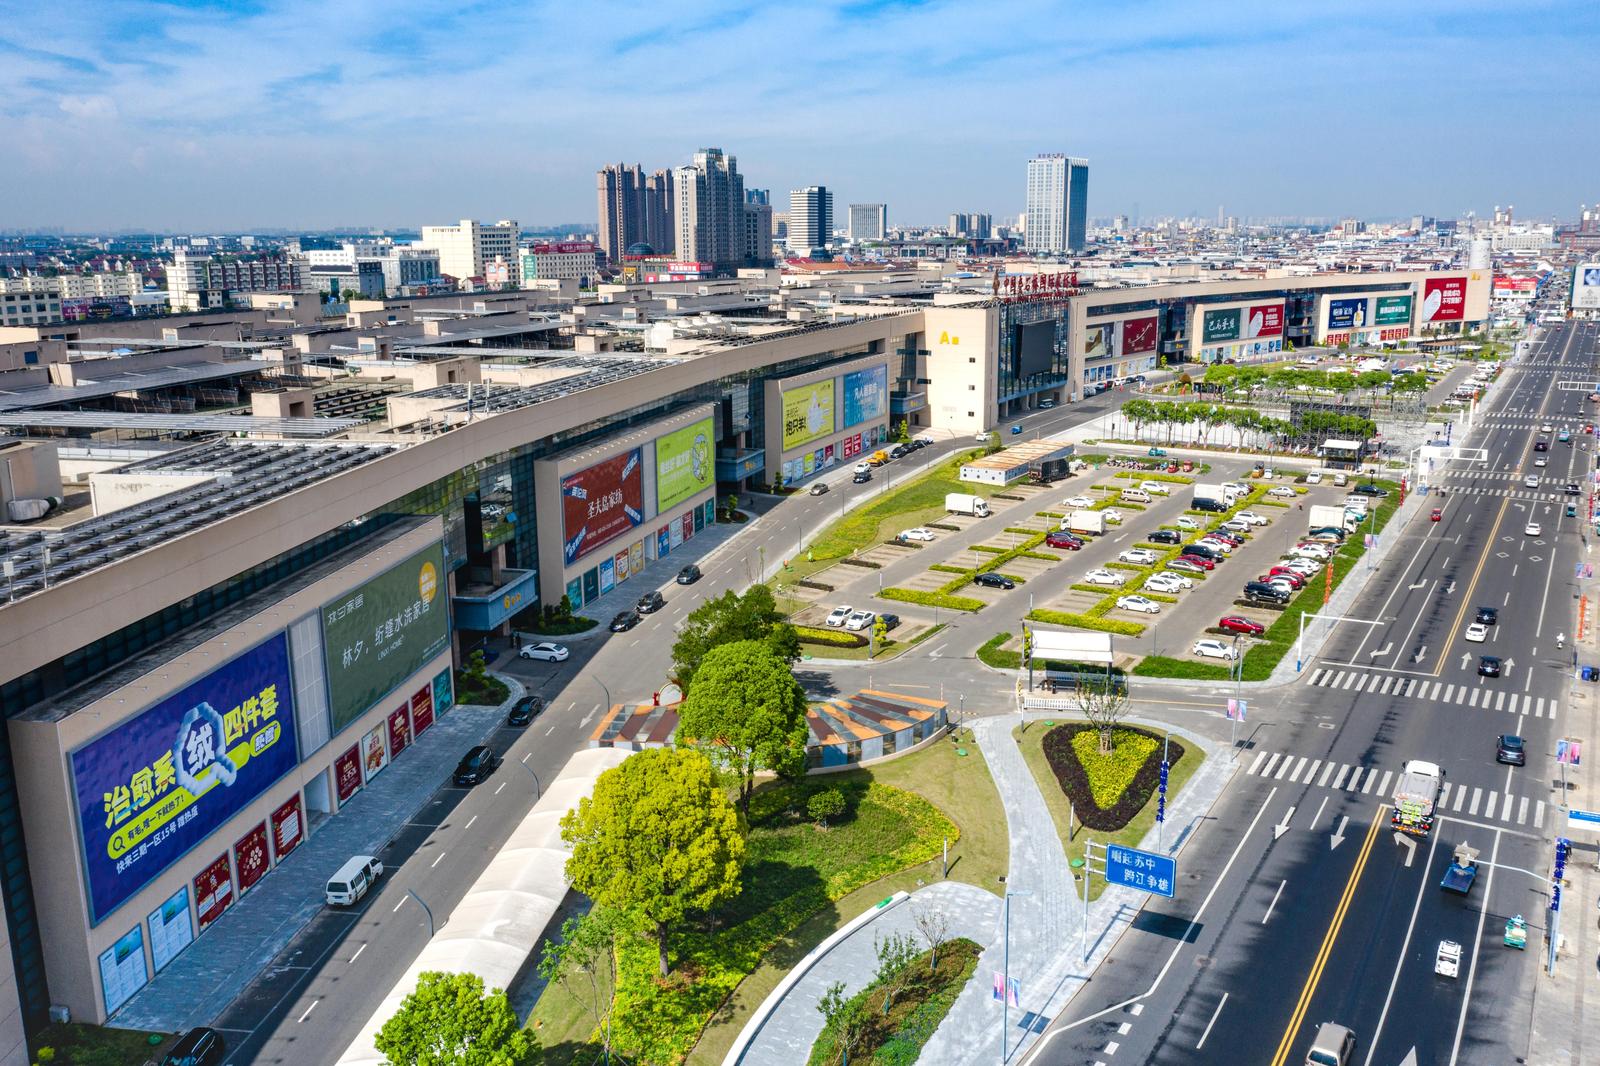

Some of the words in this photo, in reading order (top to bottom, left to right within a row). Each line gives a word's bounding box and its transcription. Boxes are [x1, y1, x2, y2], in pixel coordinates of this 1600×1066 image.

[102, 749, 177, 830] 治愈系
[186, 724, 216, 770] 绒
[222, 683, 280, 746] 四件套
[1111, 849, 1156, 870] 崛起苏中
[1124, 868, 1169, 892] 跨江争雄
